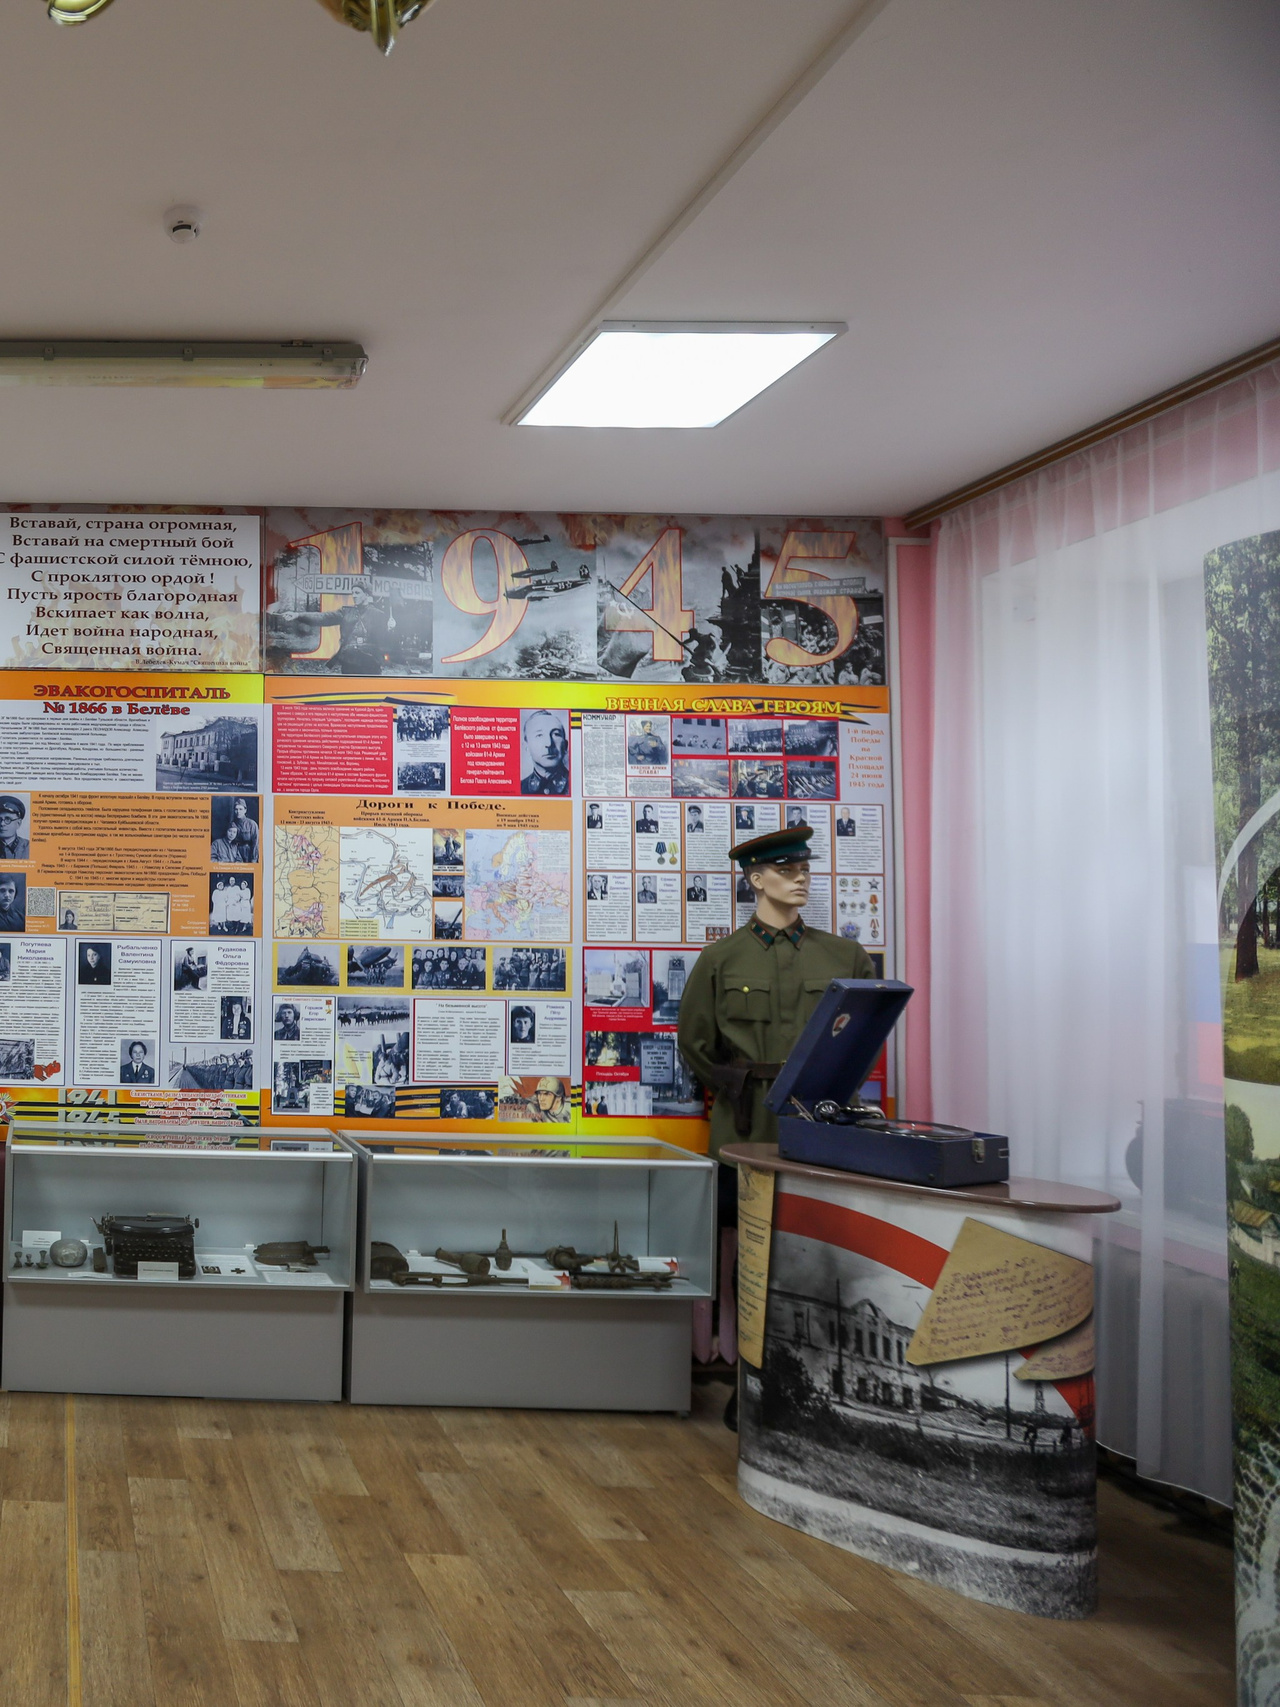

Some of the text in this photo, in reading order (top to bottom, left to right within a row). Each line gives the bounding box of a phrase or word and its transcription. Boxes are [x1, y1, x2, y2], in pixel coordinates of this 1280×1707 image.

[10, 516, 238, 532] Вставай, страна огромная,
[12, 534, 234, 550] Вставай на смертный бой
[10, 552, 118, 567] фашистской
[124, 553, 174, 566] силой
[180, 554, 253, 568] тёмною,
[32, 570, 43, 583] С
[48, 572, 146, 586] проклятою
[152, 572, 204, 586] ордой
[8, 588, 238, 604] Пусть ярость благородная
[36, 606, 209, 622] Вскипает как волна,
[26, 624, 218, 641] Идет война народная,
[42, 643, 202, 657] Священная война.
[34, 685, 231, 700] ЭВАКОГОСПИТАЛЬ
[43, 702, 190, 716] № 1866 в Белёве
[606, 697, 842, 714] ВЕЧНАЯ СЛАВА ГЕРОЯМ
[356, 799, 413, 810] Дороги
[448, 801, 506, 811] Победе.
[58, 1088, 117, 1105] 1941
[58, 1109, 120, 1123] 1945
